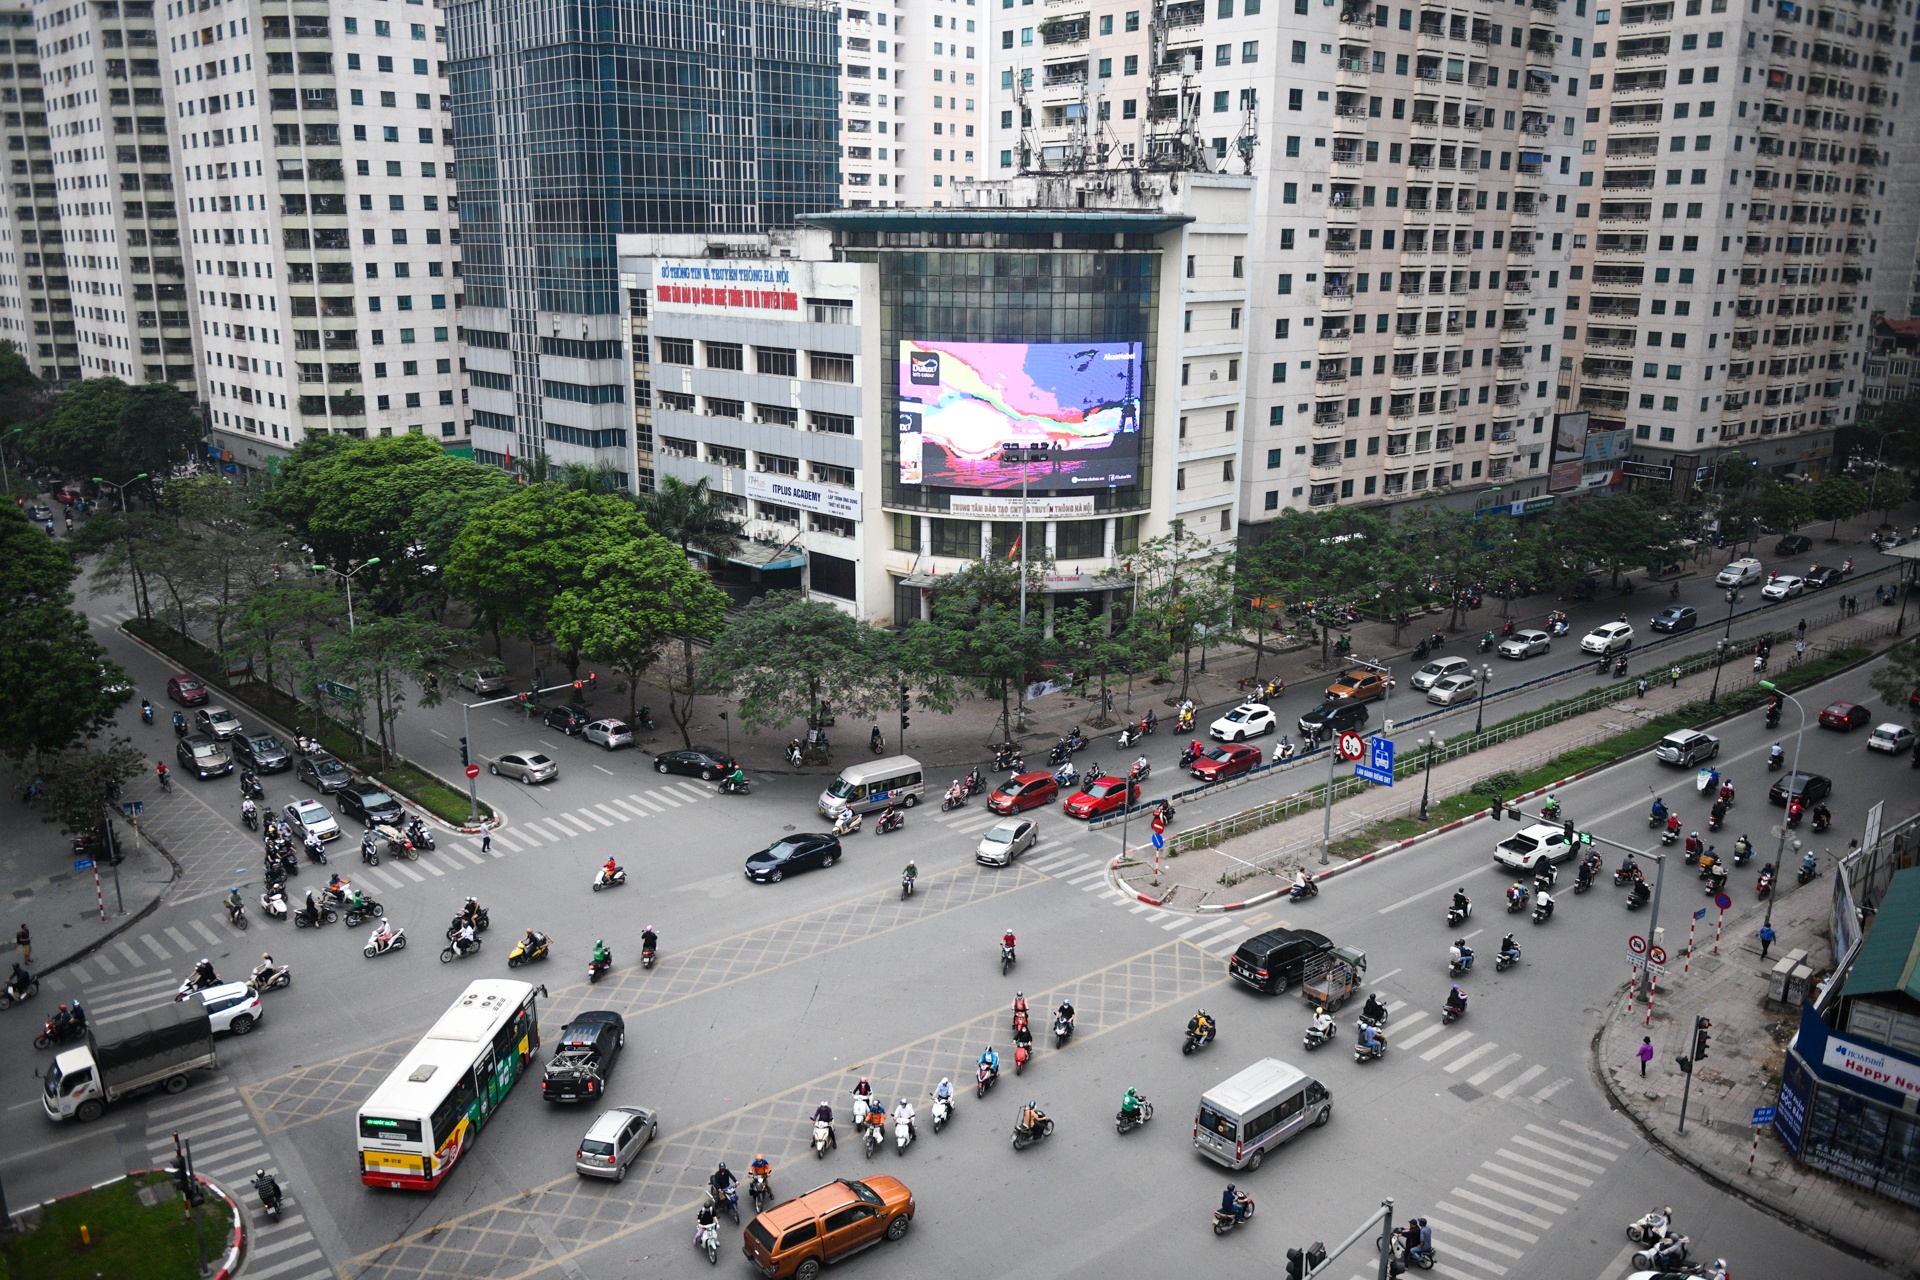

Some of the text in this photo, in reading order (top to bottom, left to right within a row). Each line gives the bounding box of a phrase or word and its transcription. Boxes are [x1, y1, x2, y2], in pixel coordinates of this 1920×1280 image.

[670, 263, 690, 279] THÔNG
[690, 267, 702, 279] TIN
[739, 265, 763, 282] THÔNG
[764, 265, 775, 282] HÀ
[776, 266, 789, 286] NỘI
[772, 484, 792, 497] ITPLUS
[793, 488, 821, 502] ACADEMY
[952, 503, 971, 512] TRUNG
[971, 502, 984, 513] TÂM
[984, 503, 996, 513] ĐÀO
[997, 505, 1009, 514] TẠO
[1055, 503, 1073, 513] THÔNG
[1074, 502, 1082, 512] HÀ
[1581, 833, 1590, 844] 36
[1846, 1059, 1891, 1083] Happy
